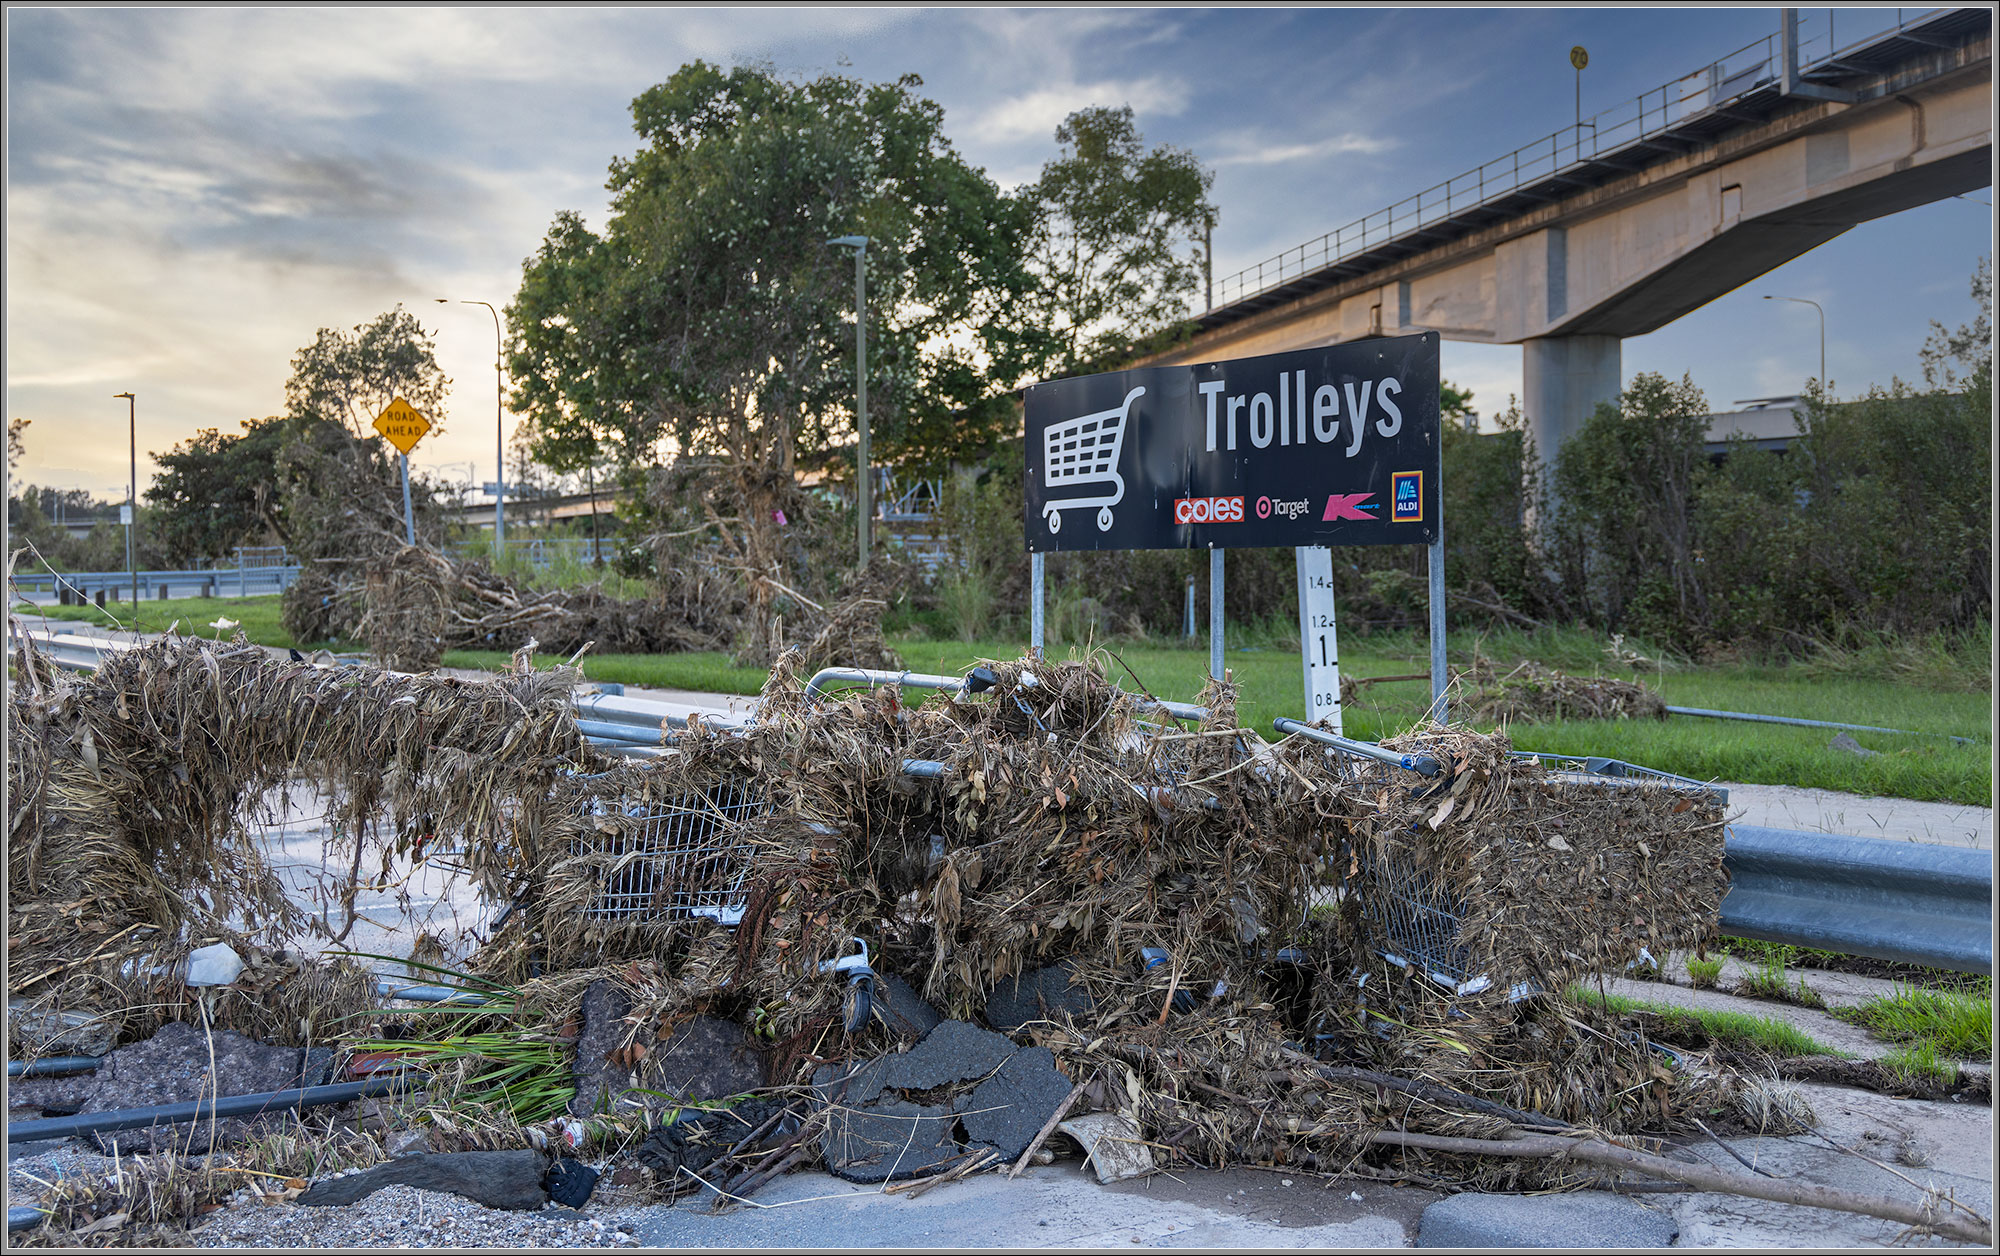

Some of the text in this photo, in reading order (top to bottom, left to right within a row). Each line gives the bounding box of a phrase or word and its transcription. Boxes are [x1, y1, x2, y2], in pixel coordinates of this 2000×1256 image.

[1572, 50, 1588, 66] 70
[387, 410, 415, 421] ROAD
[1199, 369, 1402, 458] Trolleys
[386, 426, 421, 437] AHEAD
[1176, 497, 1243, 522] coles
[1271, 498, 1310, 520] Target
[1397, 501, 1418, 512] ALDI
[1309, 575, 1324, 589] 1.4
[1312, 614, 1327, 628] 1.2
[1319, 634, 1327, 667] 1
[1315, 692, 1333, 707] 0.8
